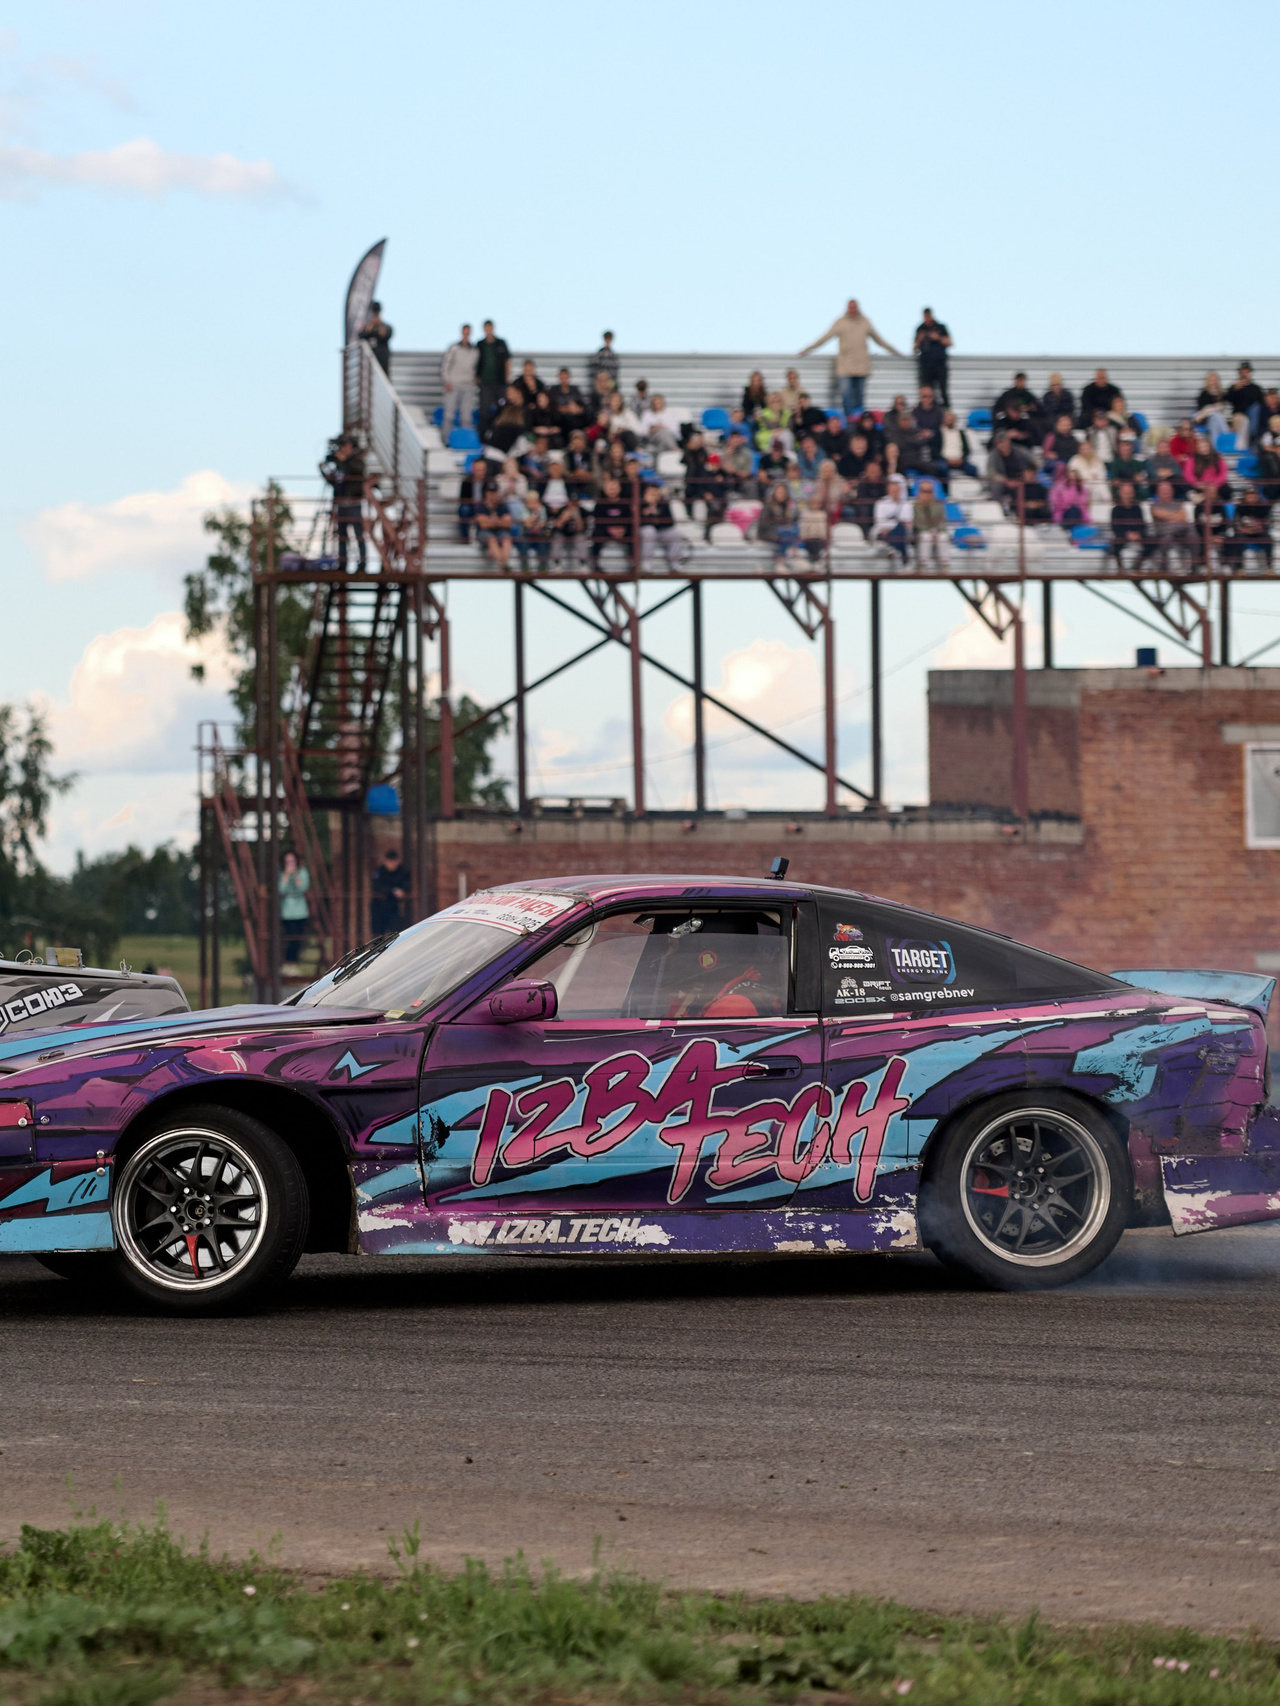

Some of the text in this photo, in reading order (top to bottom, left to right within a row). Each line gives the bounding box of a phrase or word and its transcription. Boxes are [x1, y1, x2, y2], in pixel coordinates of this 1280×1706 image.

[891, 948, 949, 968] TARGET
[862, 981, 891, 989] DRIFT
[834, 996, 887, 1004] 200SX
[898, 987, 975, 1002] samgrebnev
[658, 1055, 910, 1204] TECH
